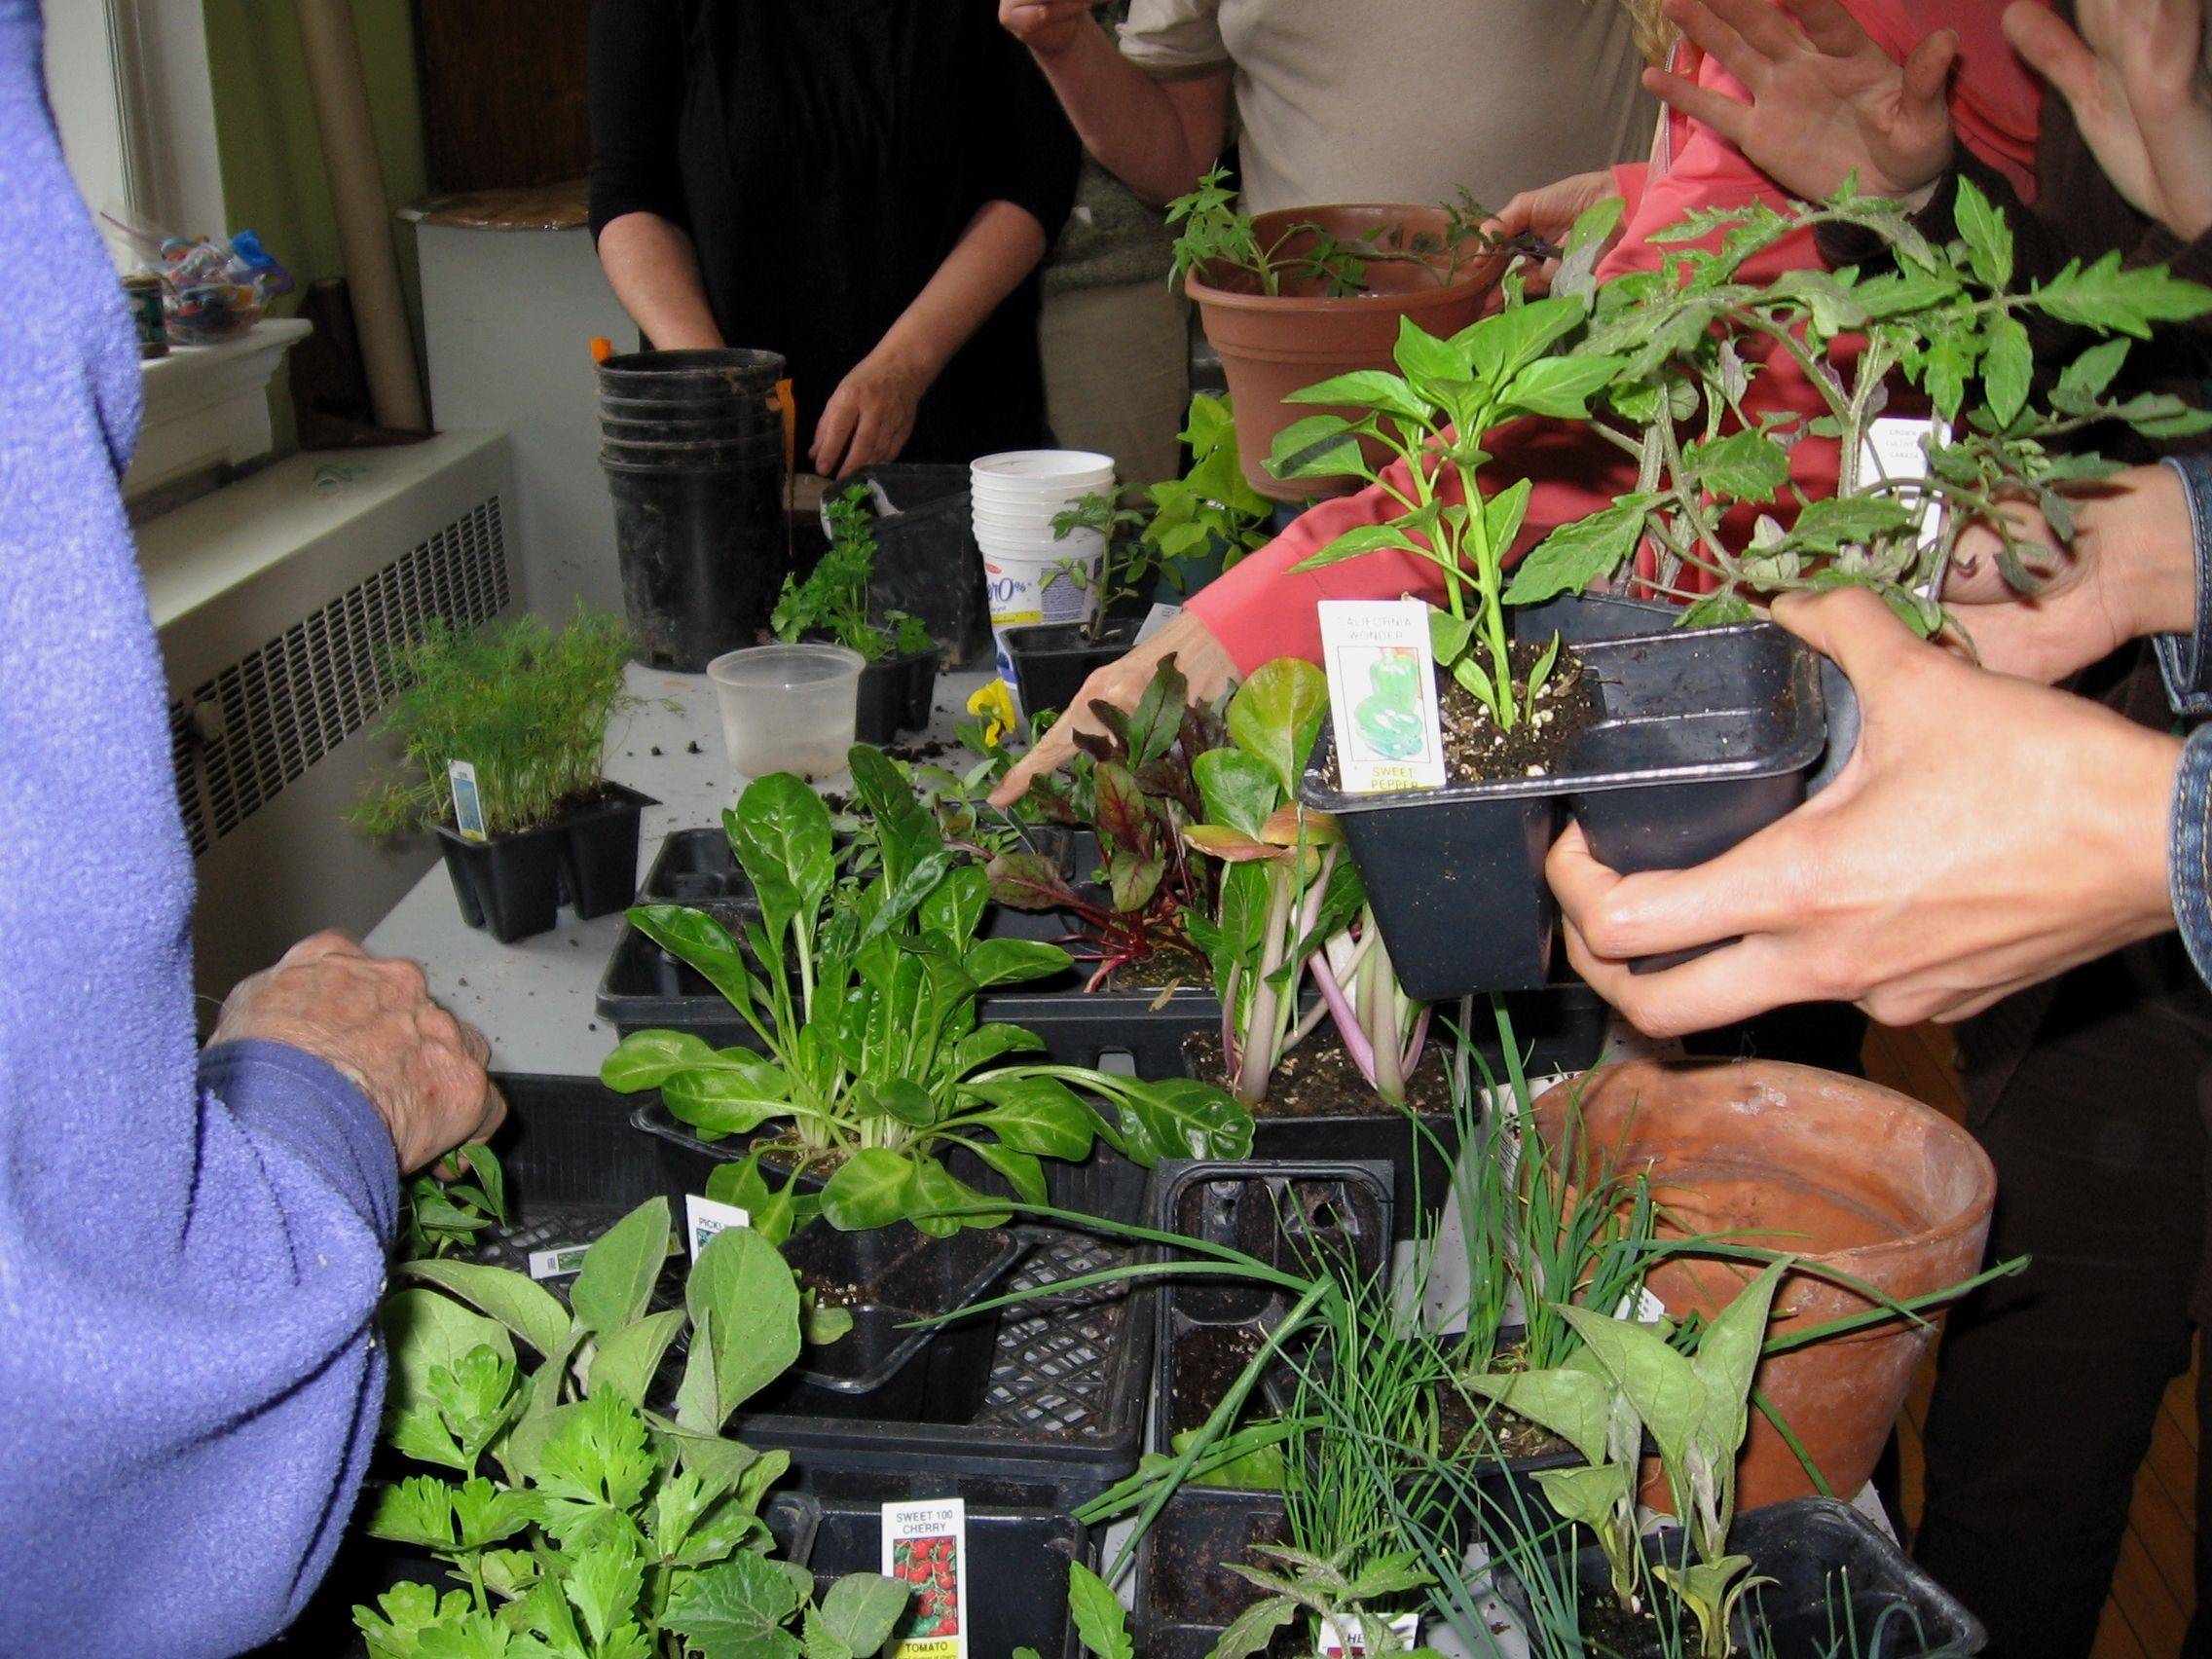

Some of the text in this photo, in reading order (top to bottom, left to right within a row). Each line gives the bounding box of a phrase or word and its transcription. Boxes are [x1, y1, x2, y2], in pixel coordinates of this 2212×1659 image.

[1348, 630, 1403, 641] WONDER
[1372, 766, 1415, 778] SWEET
[1371, 780, 1419, 790] PEPPER
[897, 1510, 953, 1523] SWEET 100
[903, 1523, 946, 1534] CHERRY
[904, 1641, 948, 1653] TOMATO
